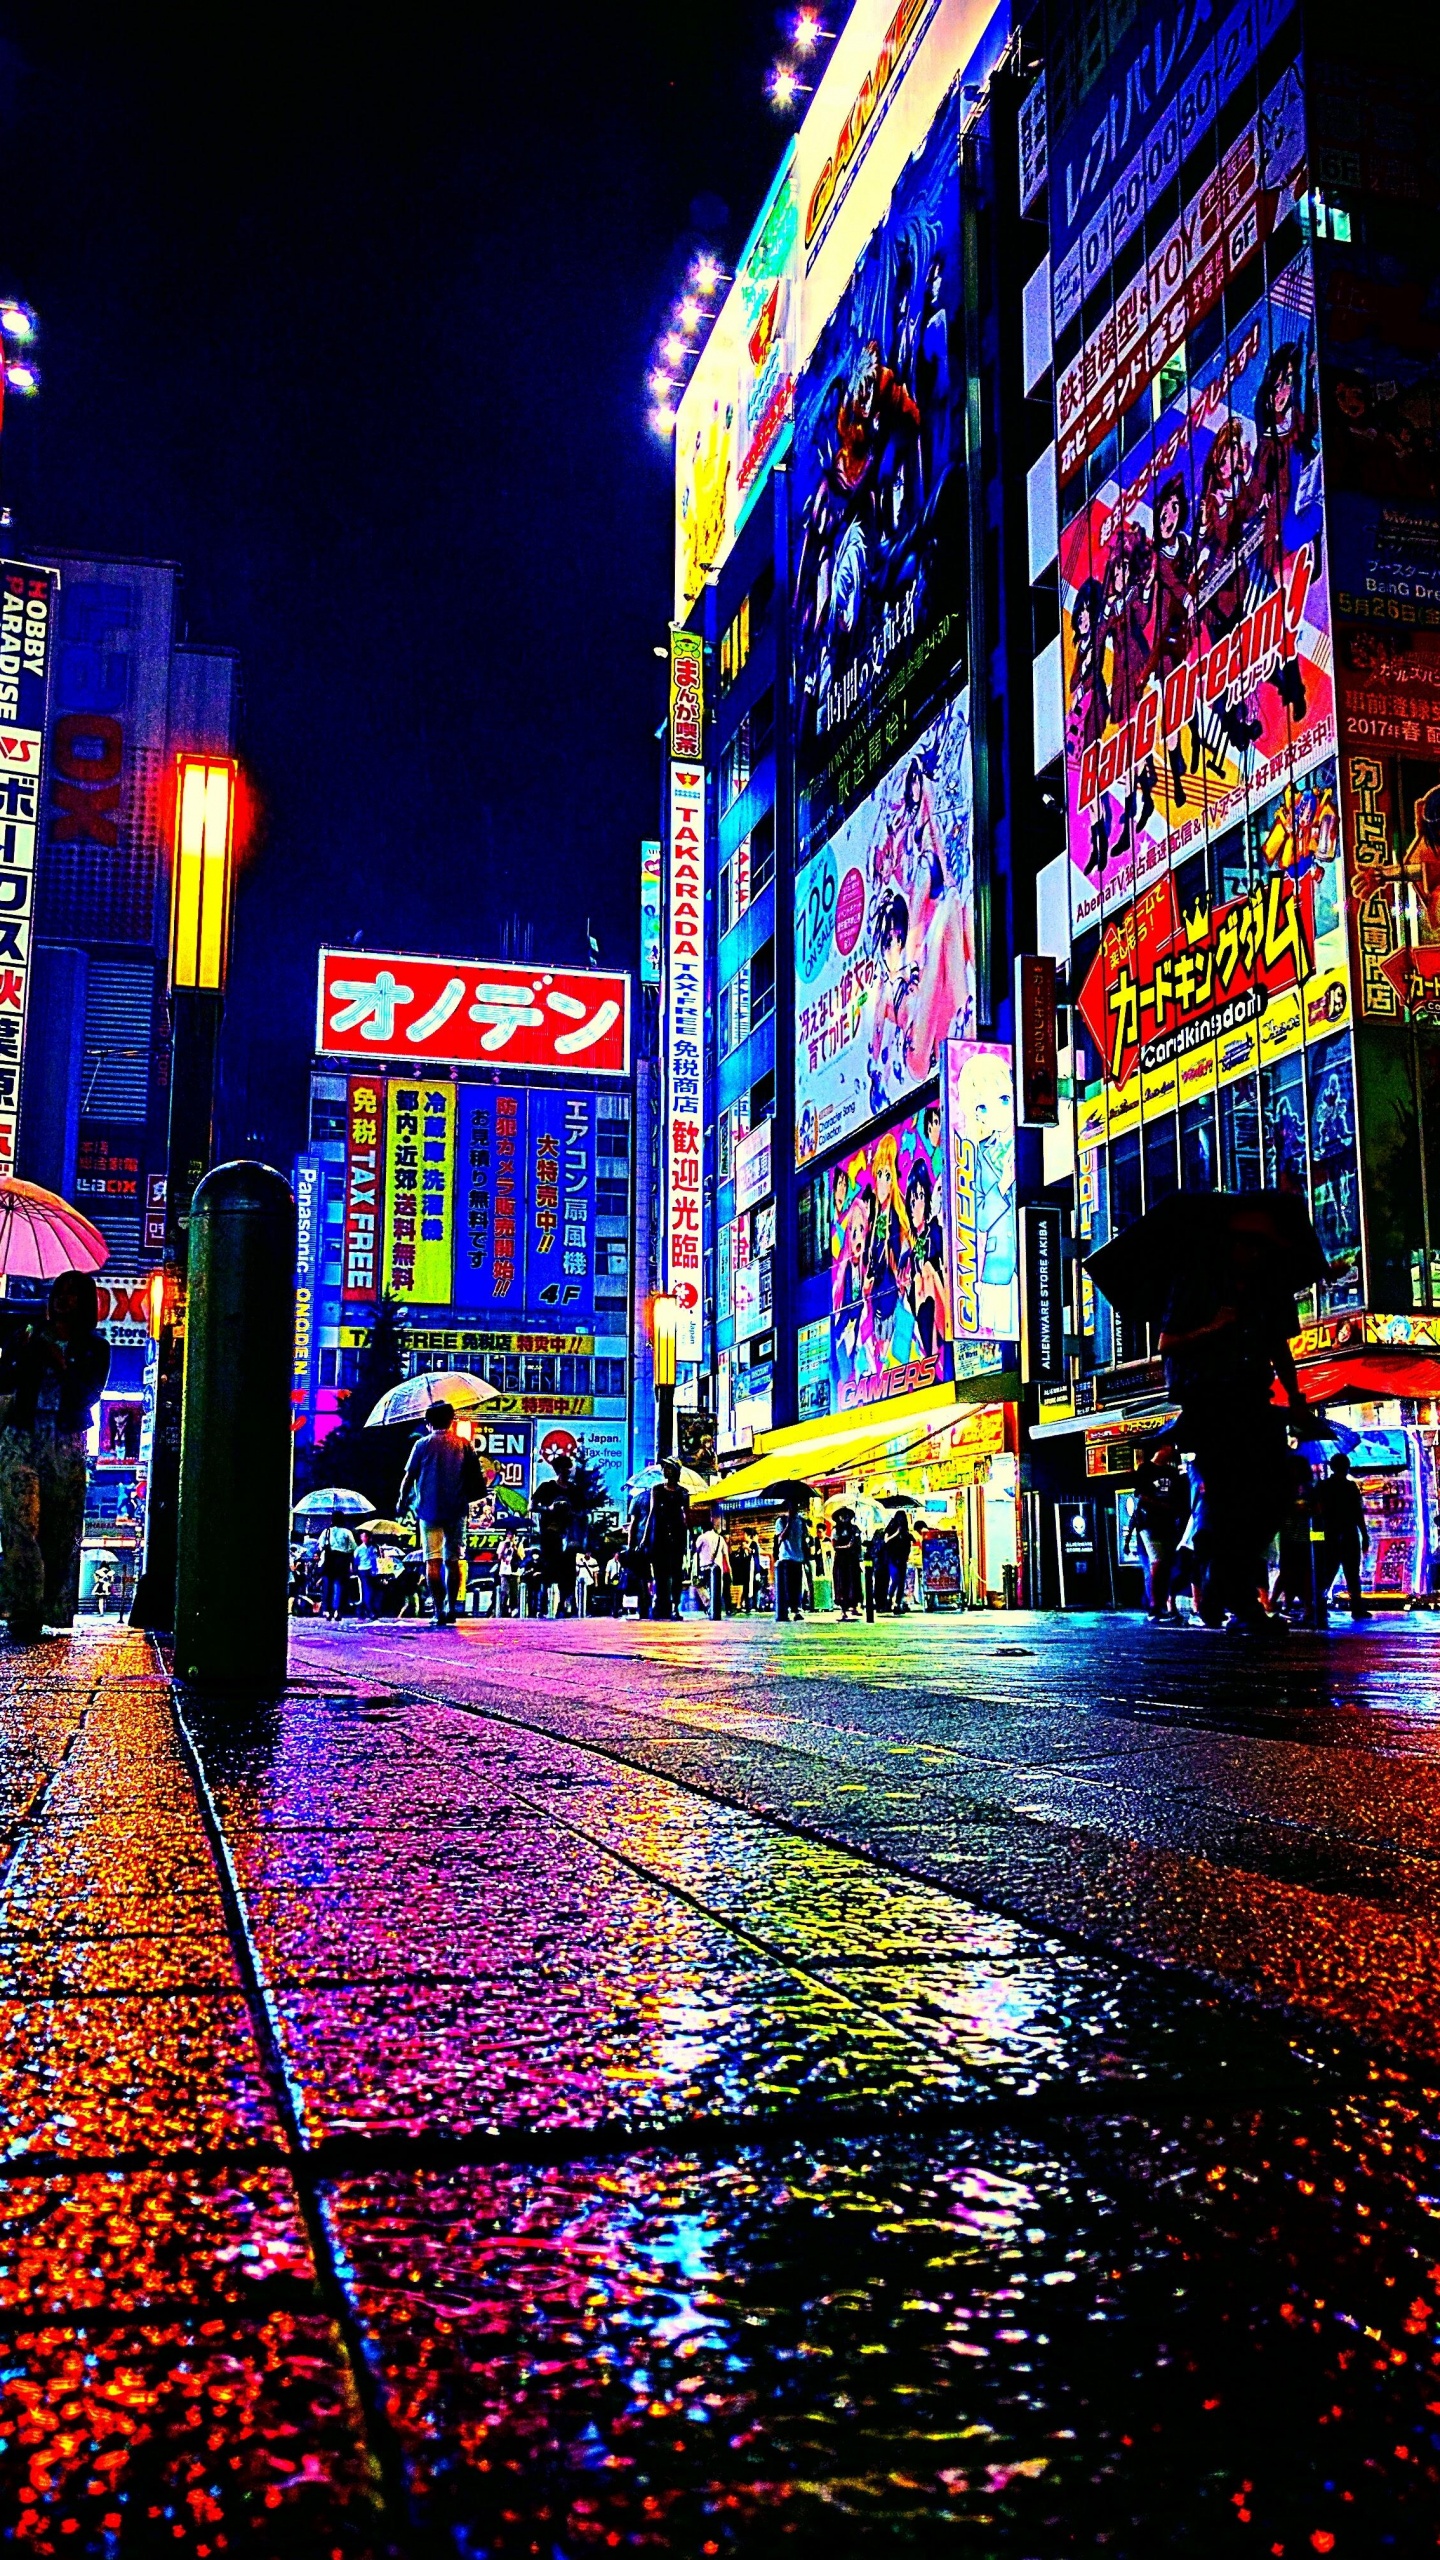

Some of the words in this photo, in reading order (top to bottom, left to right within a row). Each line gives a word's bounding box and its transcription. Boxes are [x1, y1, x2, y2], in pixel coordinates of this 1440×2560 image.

[1231, 212, 1256, 264] 6F
[1365, 578, 1410, 597] BanG
[23, 579, 47, 677] HOBBY
[673, 657, 701, 756] まんが喫茶
[1079, 693, 1160, 813] BanG
[1163, 545, 1313, 739] Dream!
[1347, 717, 1421, 742] 2017年春
[674, 806, 699, 956] TAKARADA
[796, 861, 835, 963] 7.26
[1354, 762, 1391, 1010] カードゲム専門店
[805, 947, 818, 978] ON
[817, 914, 835, 955] SALE
[1109, 877, 1310, 1078] カードキングダム
[330, 970, 620, 1055] オノデン
[672, 1040, 700, 1114] 免税商店
[352, 1087, 377, 1145] 免税
[819, 1108, 842, 1133] Character
[350, 1150, 376, 1206] TAX
[562, 1100, 588, 1276] エアコン扇風機
[297, 1168, 317, 1273] Panasonic
[347, 1213, 374, 1289] FREE
[954, 1130, 979, 1334] GAMERS
[1039, 1220, 1048, 1256] AKIBA
[539, 1283, 581, 1305] 4F
[1040, 1259, 1049, 1297] STORE
[294, 1287, 311, 1375] ONODEN
[349, 1329, 372, 1347] TA
[461, 1333, 512, 1351] 免税店
[1041, 1300, 1050, 1370] ALIENWARE
[840, 1353, 939, 1408] GAMERS
[473, 1434, 526, 1455] DEN
[585, 1448, 622, 1458] Tax-free
[588, 1434, 622, 1445] Japan.
[598, 1458, 622, 1468] Shop
